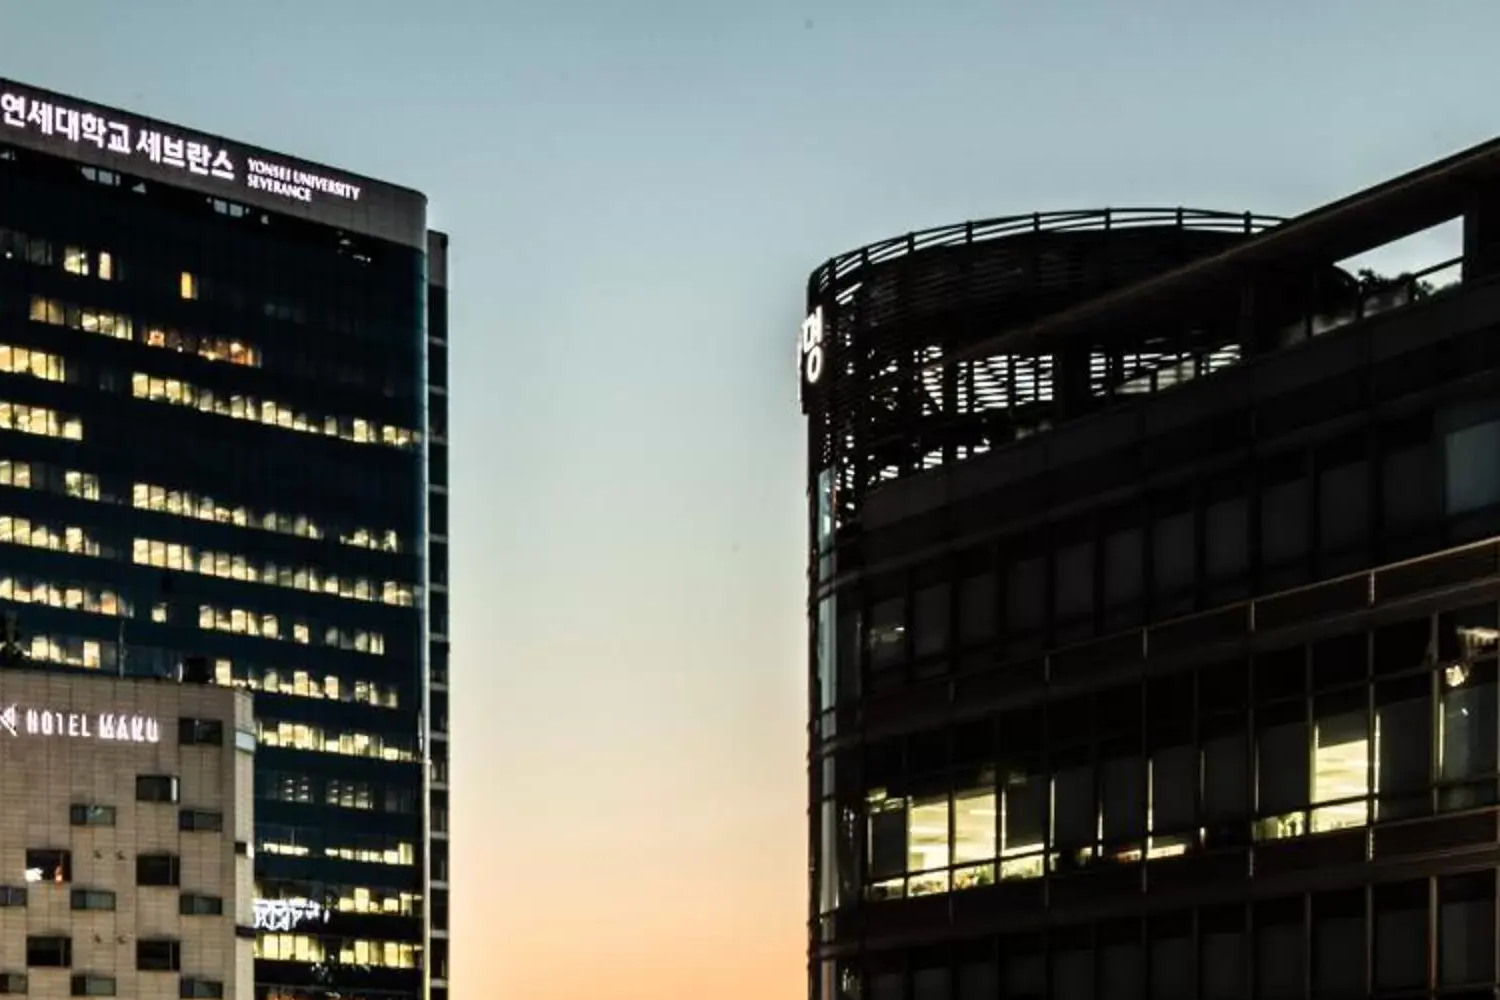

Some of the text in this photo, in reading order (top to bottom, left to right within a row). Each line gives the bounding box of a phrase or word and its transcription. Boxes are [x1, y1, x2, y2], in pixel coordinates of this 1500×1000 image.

[0, 92, 235, 181] 연세대학교 세브란스
[247, 157, 360, 201] YONSEI UNIVERSITY
[247, 173, 312, 202] SEVERANCE
[26, 708, 91, 737] HOTEL
